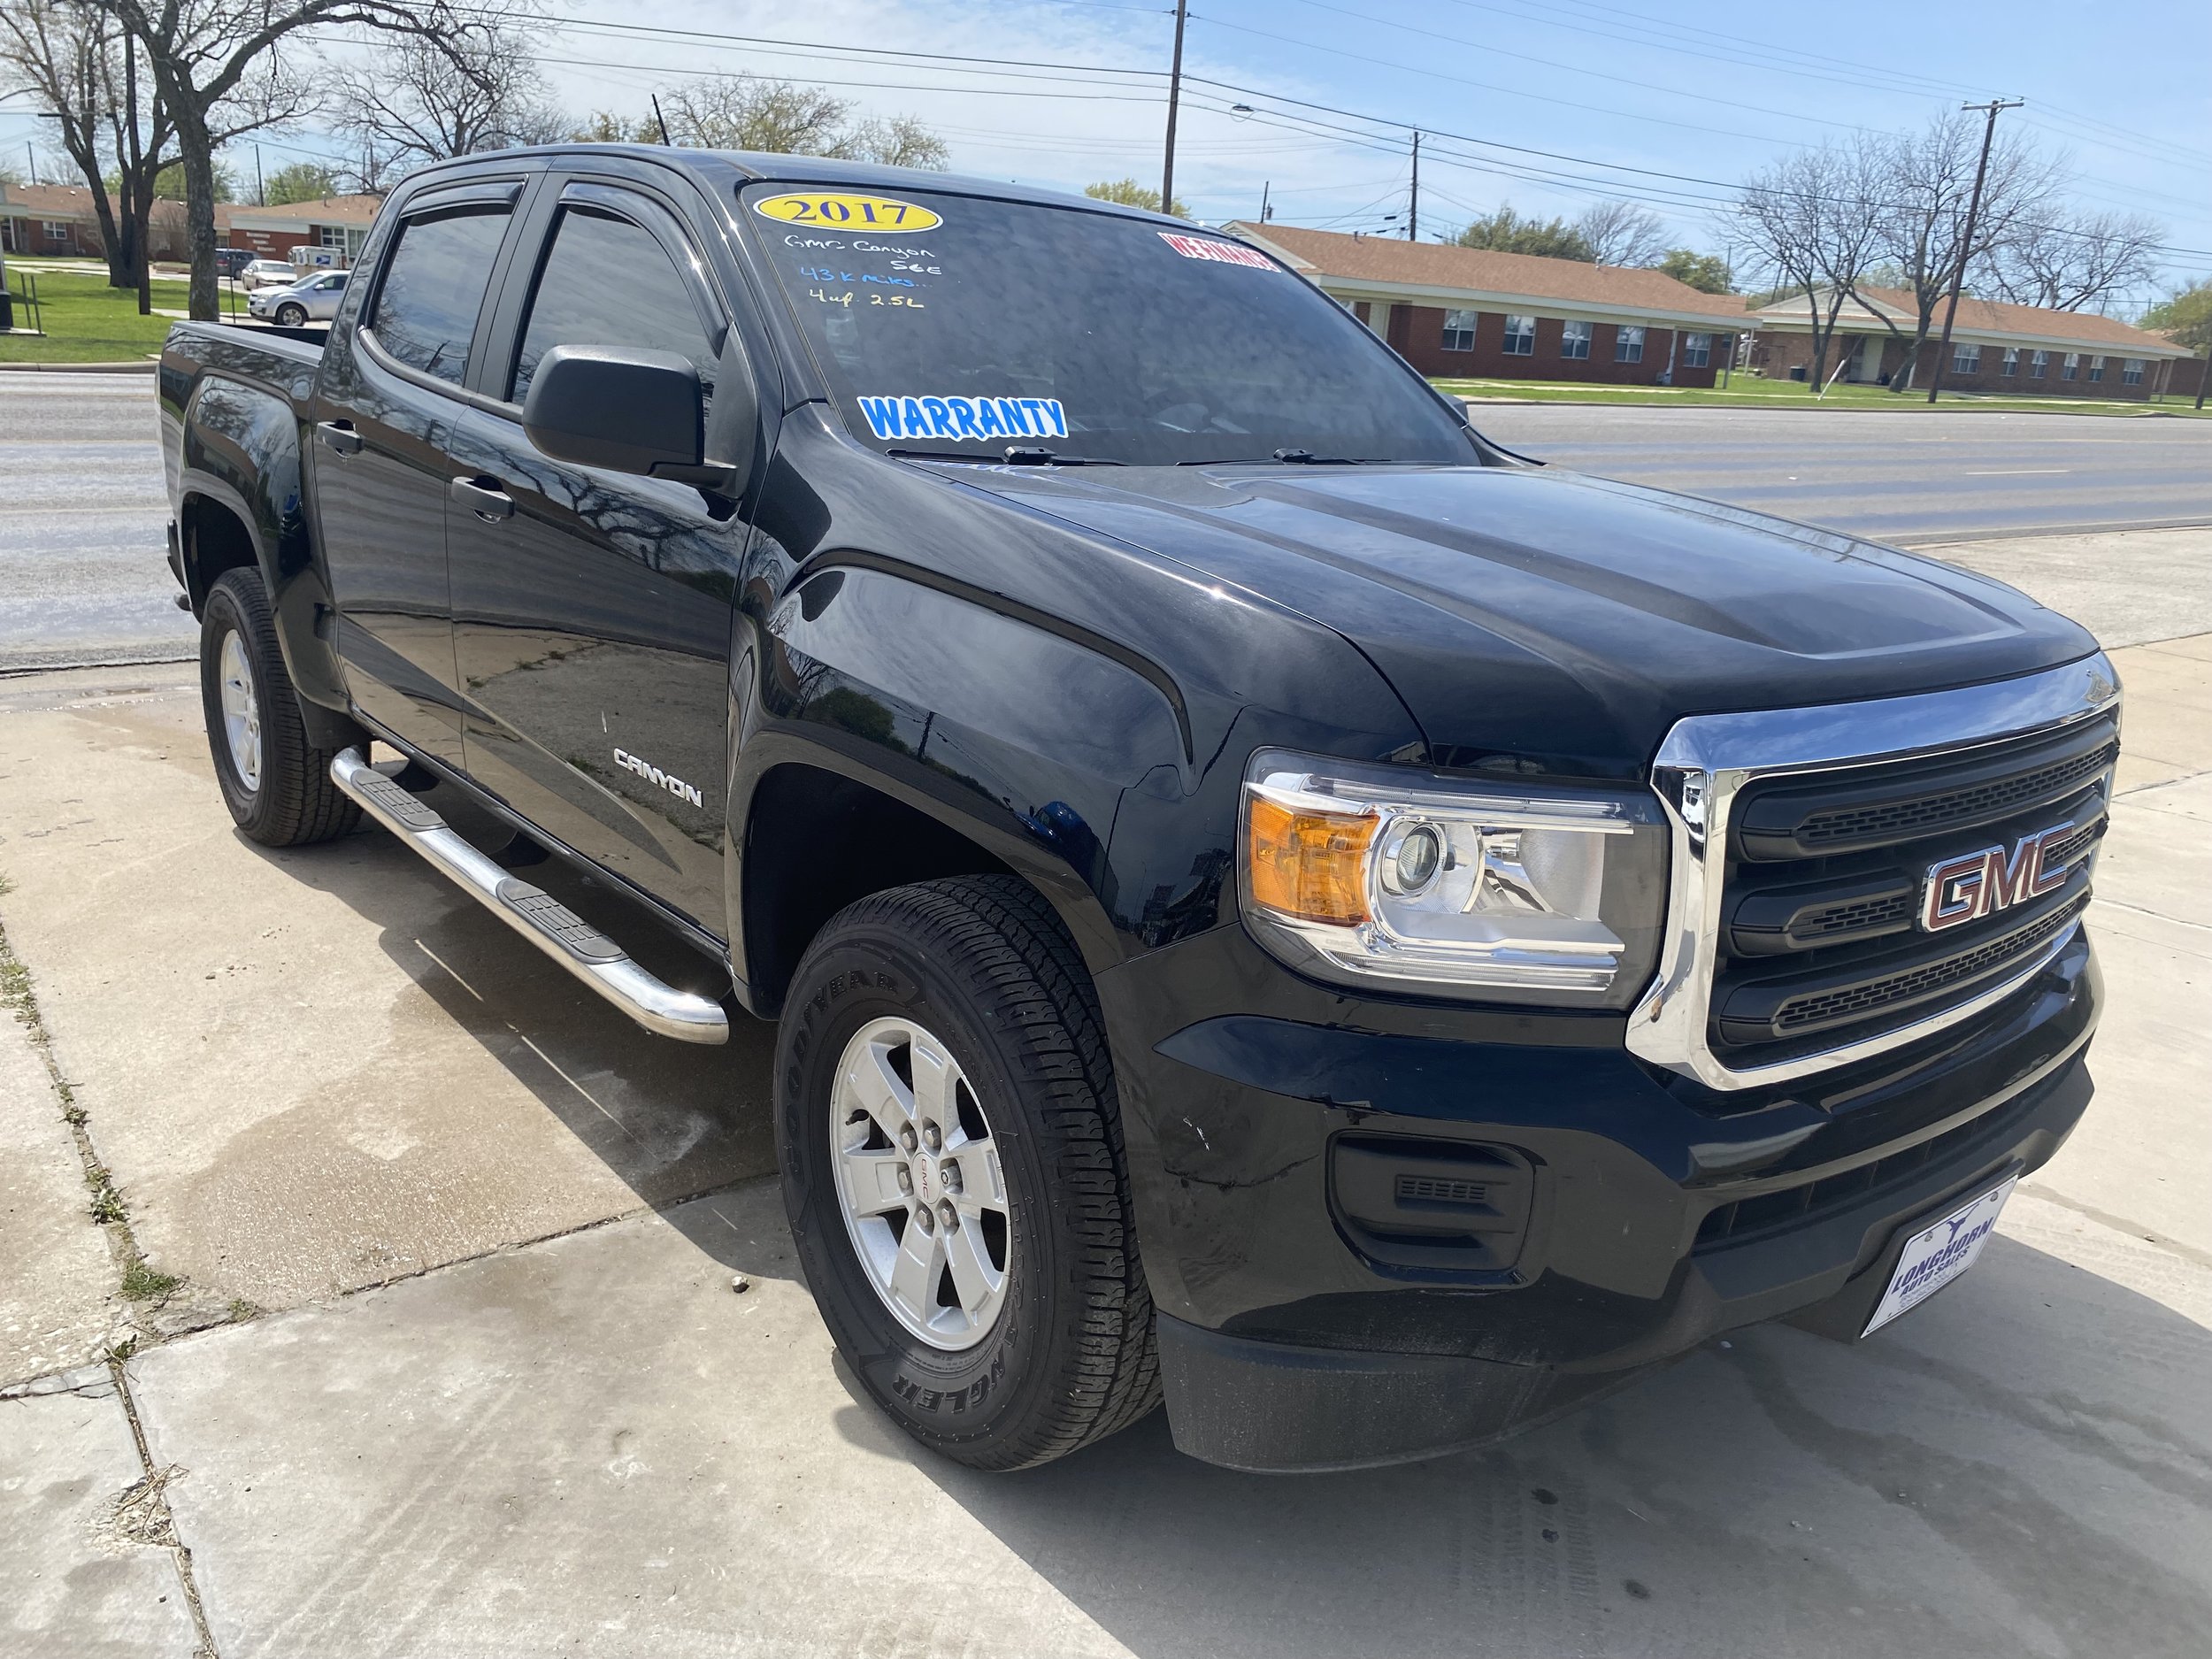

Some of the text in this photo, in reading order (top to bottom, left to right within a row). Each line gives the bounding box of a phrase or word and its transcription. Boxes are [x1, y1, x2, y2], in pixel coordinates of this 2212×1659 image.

[783, 200, 909, 225] 2017
[858, 397, 1066, 442] WARRANTY
[613, 748, 703, 809] CANYON
[1922, 820, 2076, 933] GMC
[1891, 1217, 1993, 1294] LONGHORN
[1899, 1269, 1934, 1299] AUTO
[1934, 1245, 1970, 1276] SALES
